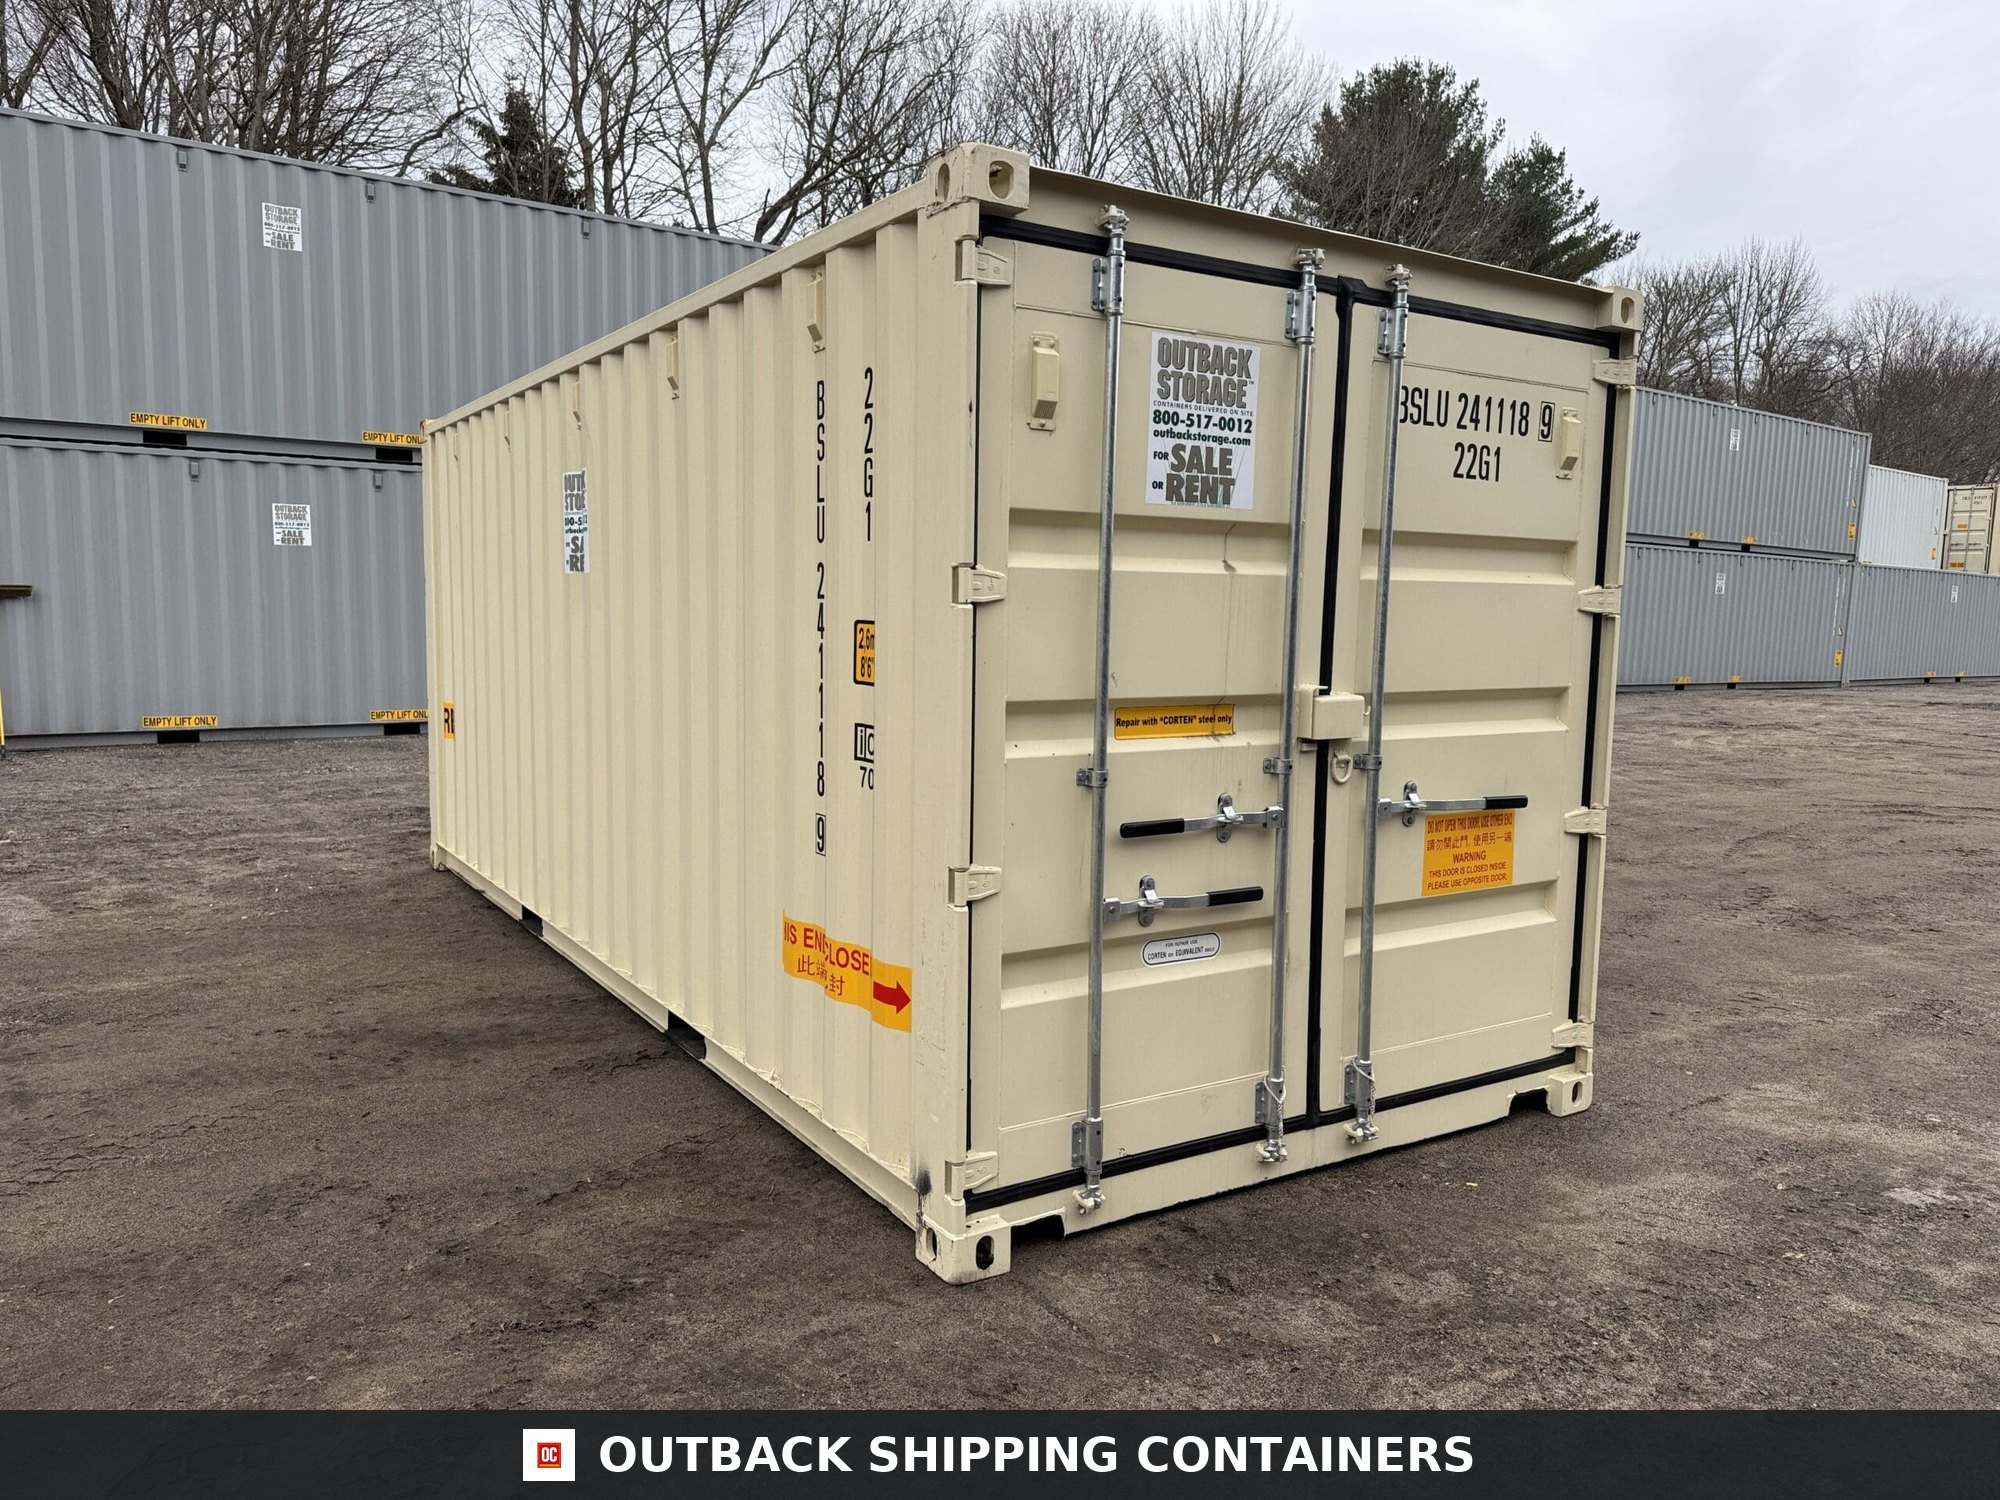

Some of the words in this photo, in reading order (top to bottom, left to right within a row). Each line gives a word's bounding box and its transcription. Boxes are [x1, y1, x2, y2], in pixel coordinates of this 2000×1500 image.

[265, 204, 298, 217] OUTBACK
[265, 213, 298, 224] STORAGE
[270, 239, 295, 249] RENT
[272, 232, 294, 242] SALE
[1157, 336, 1253, 379] OUTBACK
[1157, 369, 1247, 408] STORAGE
[1153, 400, 1192, 410] CONTAINERS
[1194, 404, 1228, 414] DELIVERED
[130, 413, 159, 424] EMPTY
[162, 416, 181, 426] LIFT
[182, 418, 205, 428] ONLY
[1152, 409, 1253, 434] 800-517-0012
[1456, 393, 1530, 436] 241118
[1540, 405, 1552, 439] 9
[363, 432, 387, 442] EMPTY
[390, 434, 404, 443] LIFT
[406, 435, 422, 444] ONL
[1153, 428, 1251, 446] outbackstorage.com
[1153, 451, 1169, 461] FOR
[1171, 443, 1233, 476] SALE
[1453, 442, 1501, 482] 22G1
[1152, 481, 1164, 490] OR
[1166, 473, 1235, 505] RENT
[144, 717, 172, 726] EMPTY
[174, 717, 192, 726] LIFT
[194, 716, 216, 725] ONLY
[371, 711, 395, 719] EMPTY
[396, 710, 411, 719] LIFT
[413, 710, 428, 718] ONL
[1116, 718, 1140, 728] Repair
[1142, 716, 1158, 726] with
[1198, 715, 1216, 724] steel
[1217, 714, 1232, 724] only
[817, 817, 825, 852] 9
[1428, 821, 1434, 834] DO
[1453, 850, 1486, 864] WARNING
[1429, 870, 1441, 878] THIS
[1443, 868, 1459, 876] DOOR
[1466, 864, 1488, 874] CLOSED
[1428, 880, 1449, 890] PLEASE
[1450, 879, 1461, 887] USE
[1463, 875, 1489, 885] OPPOSITE
[1148, 951, 1166, 960] CORTEN
[1175, 946, 1204, 956] EQUIVALENT
